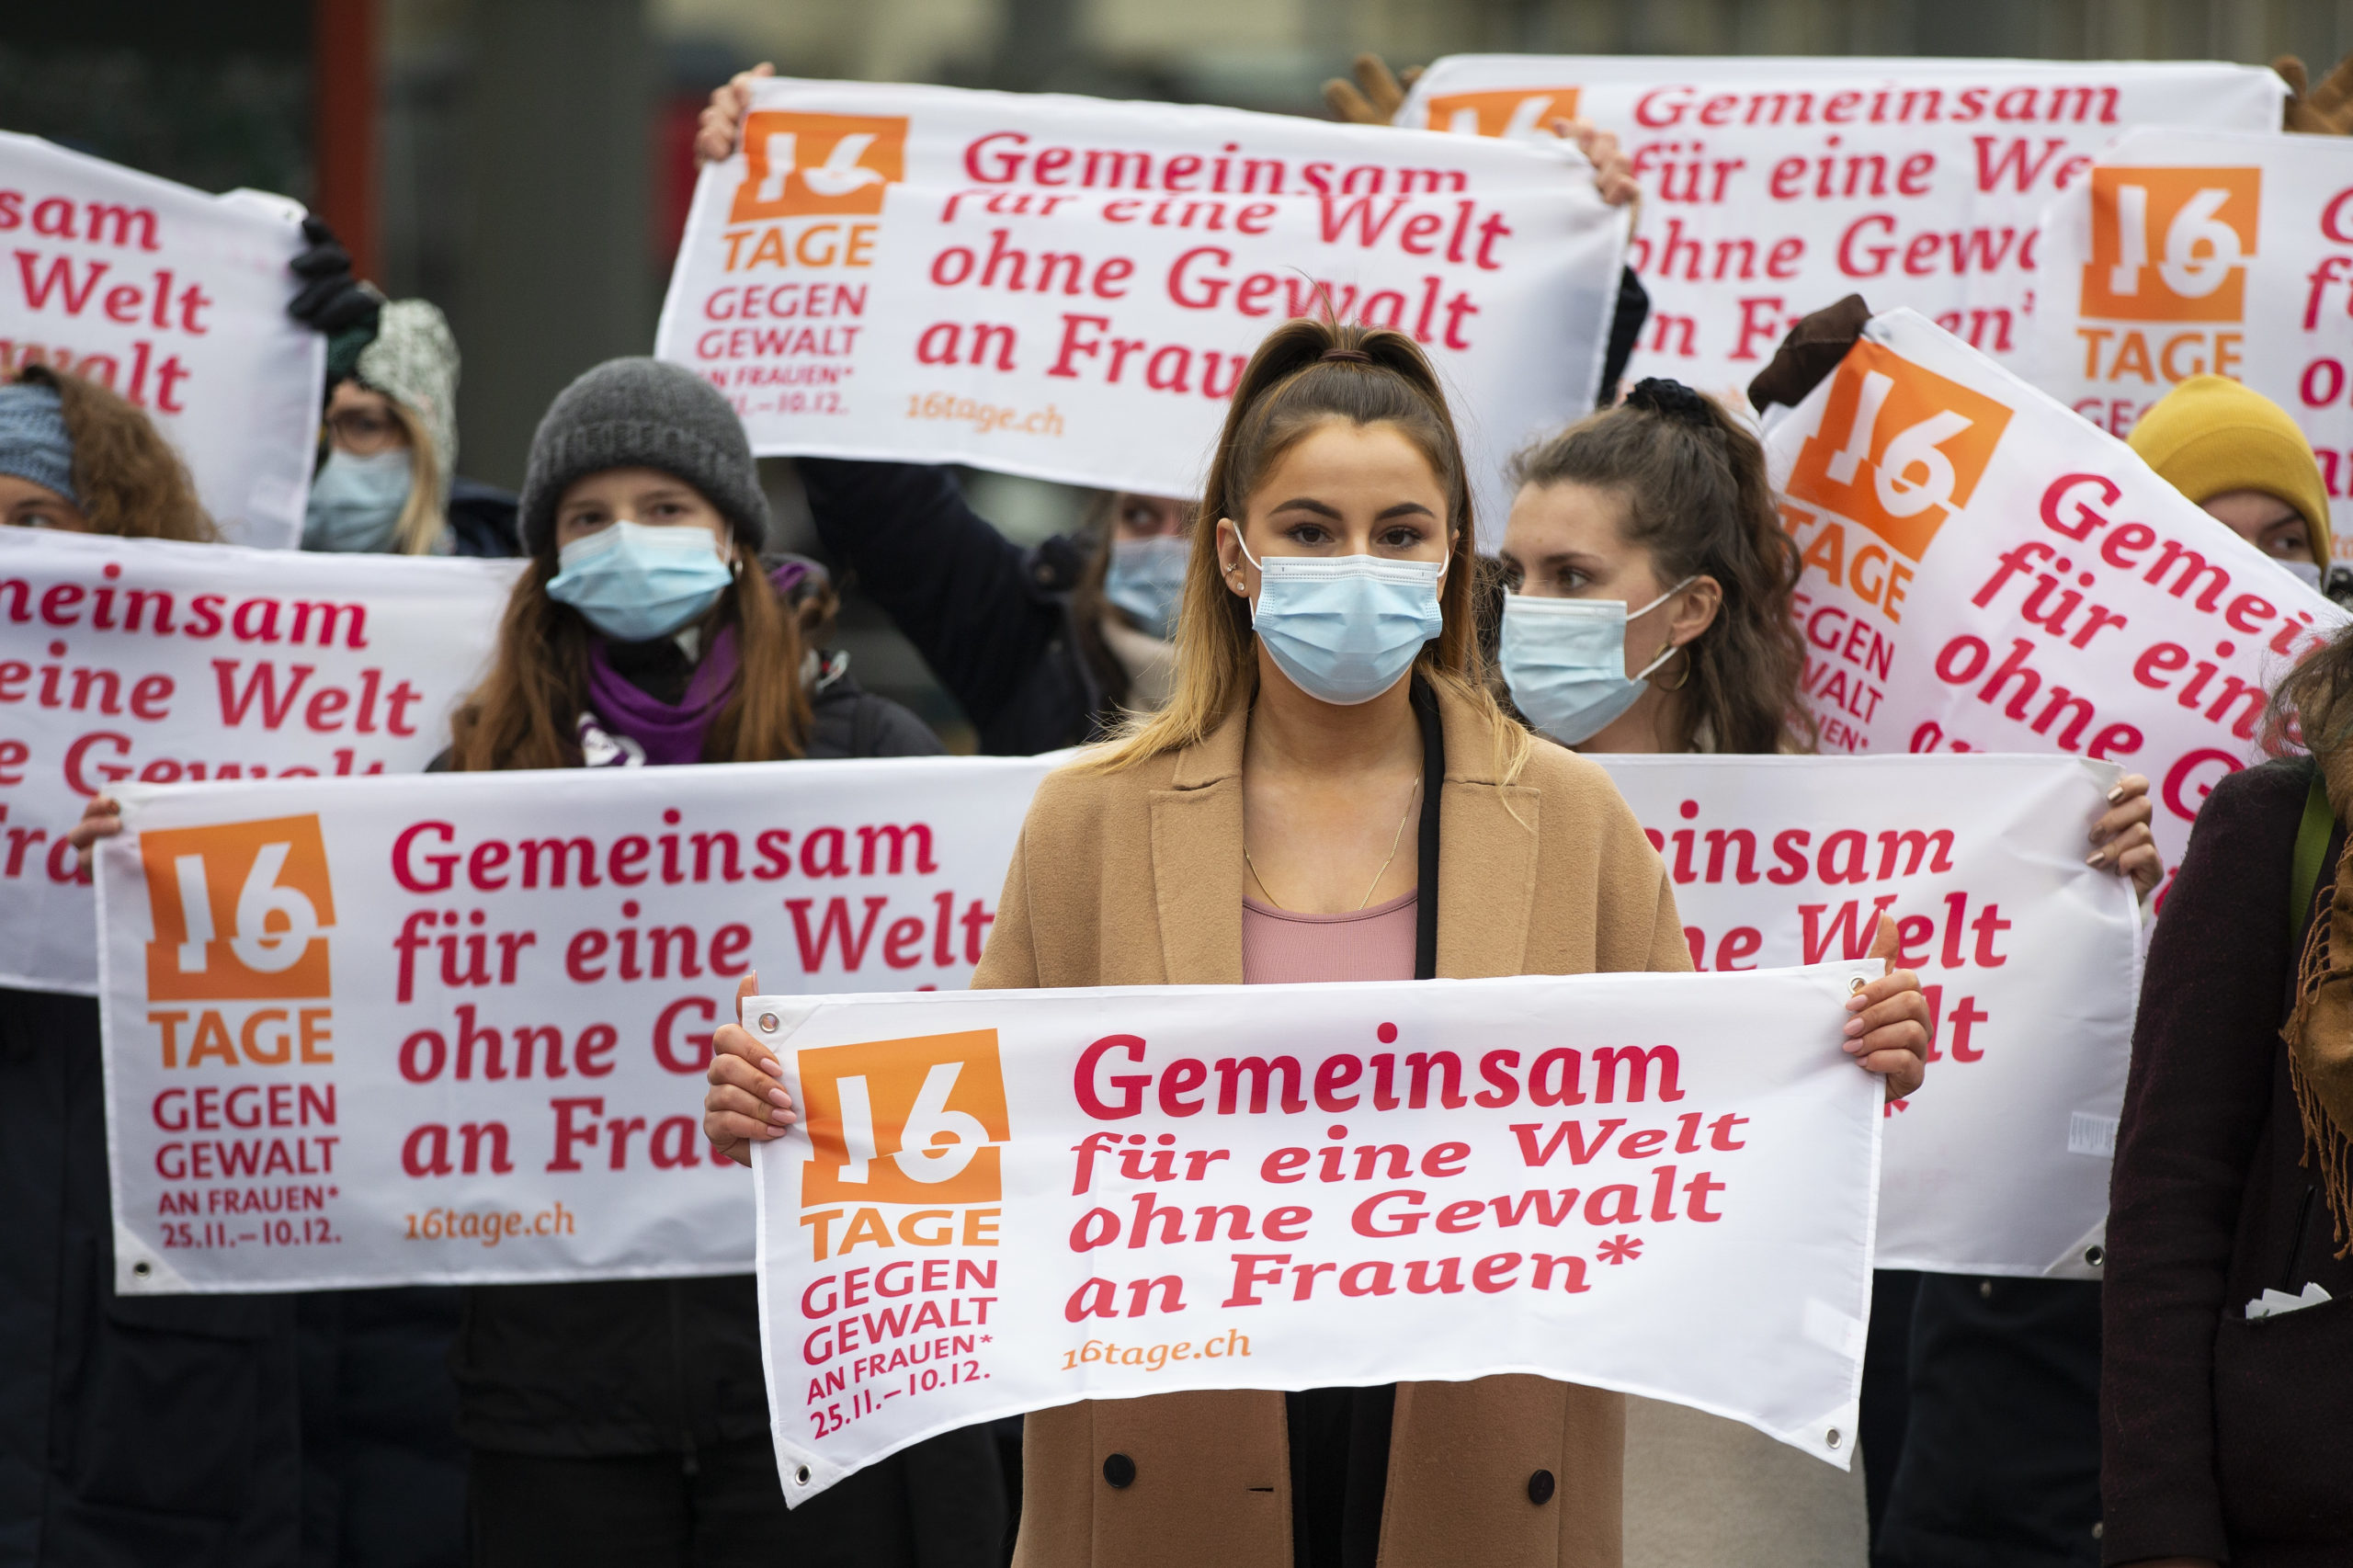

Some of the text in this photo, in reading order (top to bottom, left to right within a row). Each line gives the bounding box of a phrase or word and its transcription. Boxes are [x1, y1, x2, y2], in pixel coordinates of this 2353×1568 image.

[1635, 87, 2119, 129] Gemeinsam
[963, 132, 1466, 195] Gemeinsam
[1770, 136, 1935, 199] eine
[724, 224, 878, 272] TAGE
[931, 229, 1133, 299] ohne
[1316, 196, 1511, 271] Welt
[2108, 184, 2245, 300] 16
[14, 250, 210, 334] Welt
[706, 285, 866, 320] GEGEN
[698, 328, 857, 358] GEWALT
[917, 323, 1016, 371] an
[2076, 328, 2243, 388] TAGE
[906, 392, 1064, 437] 16tage.ch
[1824, 368, 1976, 524] 16
[1972, 541, 2128, 650] für
[211, 659, 421, 737] Welt
[1935, 634, 2143, 760] ohne
[392, 809, 938, 894] Gemeinsam
[175, 840, 317, 974] 16
[393, 892, 995, 1004] für eine Welt
[148, 1008, 334, 1068] TAGE
[399, 1004, 618, 1084] ohne
[1074, 1022, 1685, 1120] Gemeinsam
[153, 1085, 335, 1132] GEGEN
[402, 1097, 735, 1177] an Fra
[832, 1060, 991, 1186] 16
[155, 1137, 338, 1180] GEWALT
[1071, 1112, 1749, 1196] für eine Welt
[158, 1189, 201, 1217] AN
[407, 1203, 574, 1245] 16tage.ch
[1070, 1165, 1725, 1253] ohne Gewalt
[801, 1208, 1001, 1262] TAGE
[801, 1260, 997, 1320] GEGEN
[1065, 1276, 1186, 1323] an
[801, 1297, 997, 1366] GEWALT
[1063, 1329, 1250, 1370] 16tage.ch
[805, 1377, 847, 1406] AN
